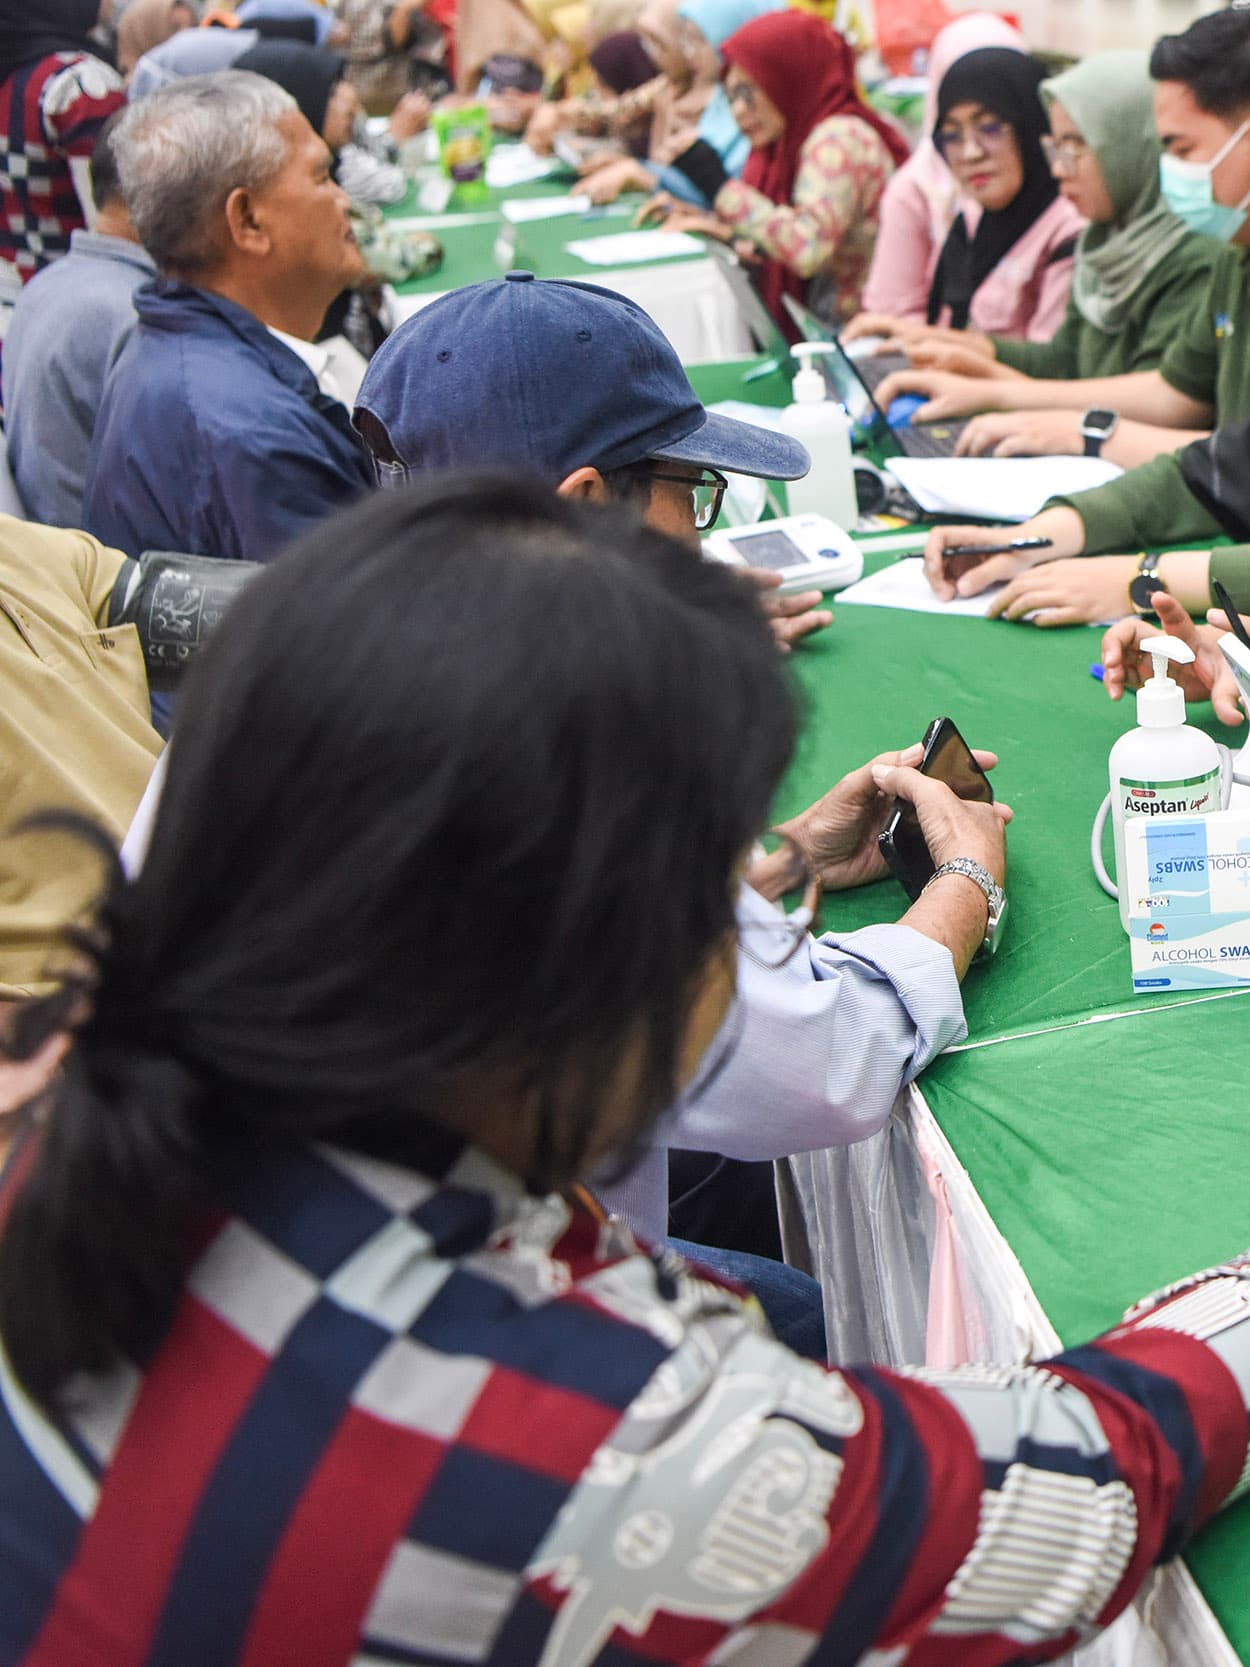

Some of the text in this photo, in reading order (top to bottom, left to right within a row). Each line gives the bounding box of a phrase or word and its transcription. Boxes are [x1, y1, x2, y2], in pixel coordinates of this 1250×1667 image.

[1125, 796, 1187, 816] Aseptan
[1155, 859, 1205, 874] SWABS
[1152, 948, 1217, 962] ALCOHOL
